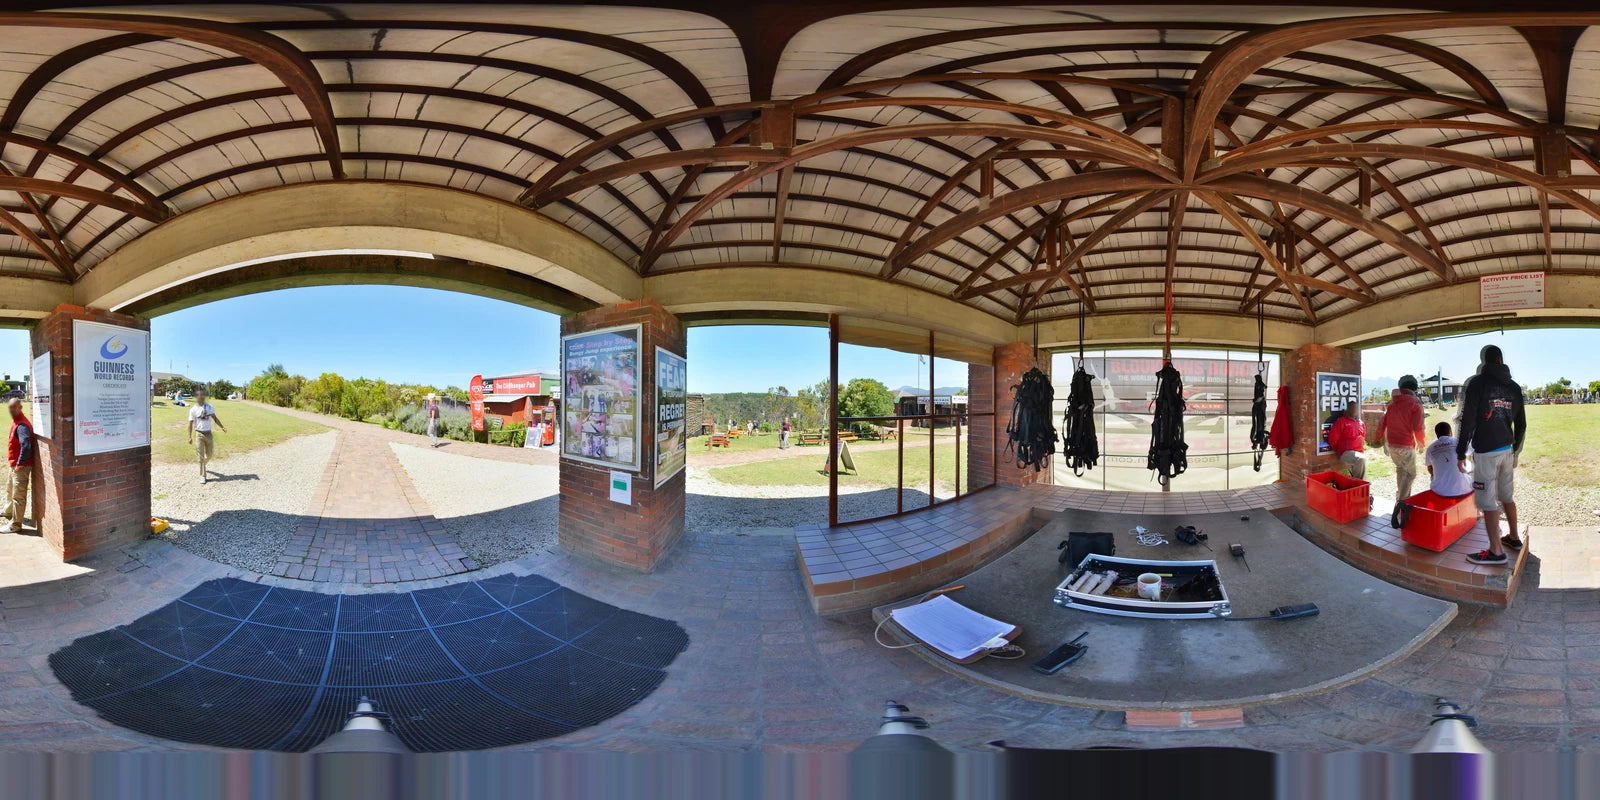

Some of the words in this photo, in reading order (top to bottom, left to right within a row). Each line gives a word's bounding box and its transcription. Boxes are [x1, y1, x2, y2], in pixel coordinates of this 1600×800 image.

[600, 345, 633, 353] experience
[94, 361, 134, 374] GUINNESS
[1111, 359, 1203, 375] BLOUKANS
[113, 374, 135, 382] RECORDS
[660, 361, 685, 390] FEAR
[1321, 380, 1358, 396] FACE
[660, 404, 685, 421] REGRET
